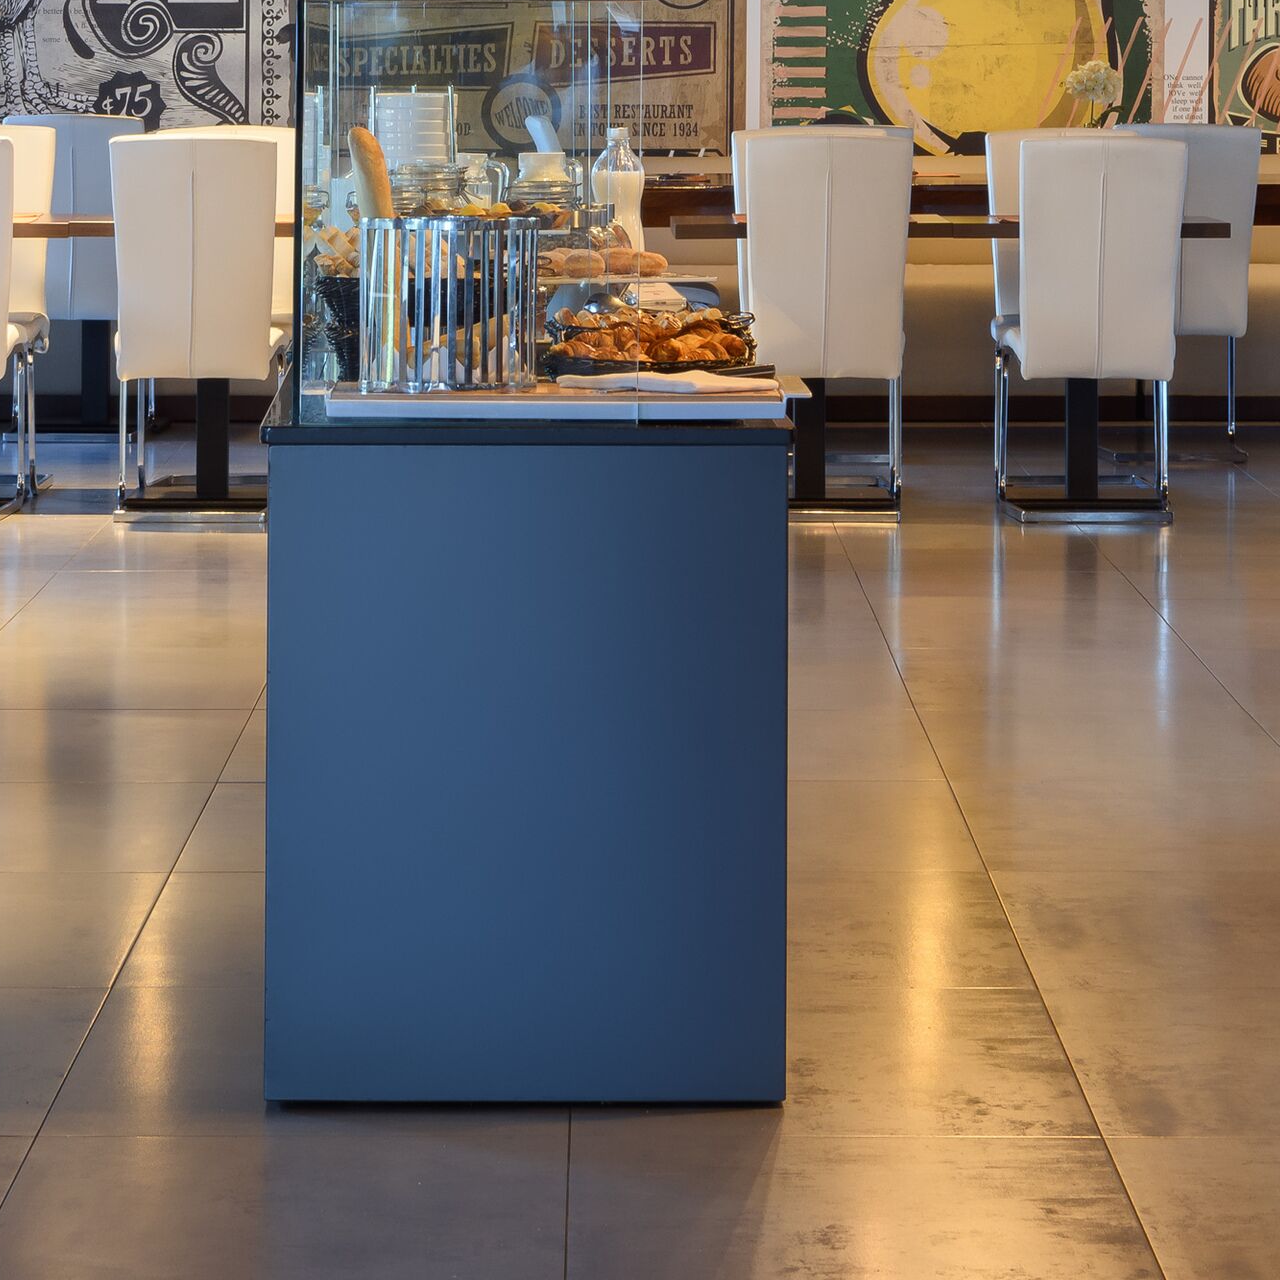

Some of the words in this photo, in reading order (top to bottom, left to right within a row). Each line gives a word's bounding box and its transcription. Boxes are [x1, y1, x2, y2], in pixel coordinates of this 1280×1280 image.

[339, 43, 497, 78] SPECIALTIES
[549, 35, 694, 69] DESERTS
[614, 104, 694, 119] RESTAURANT
[673, 122, 699, 137] 1934
